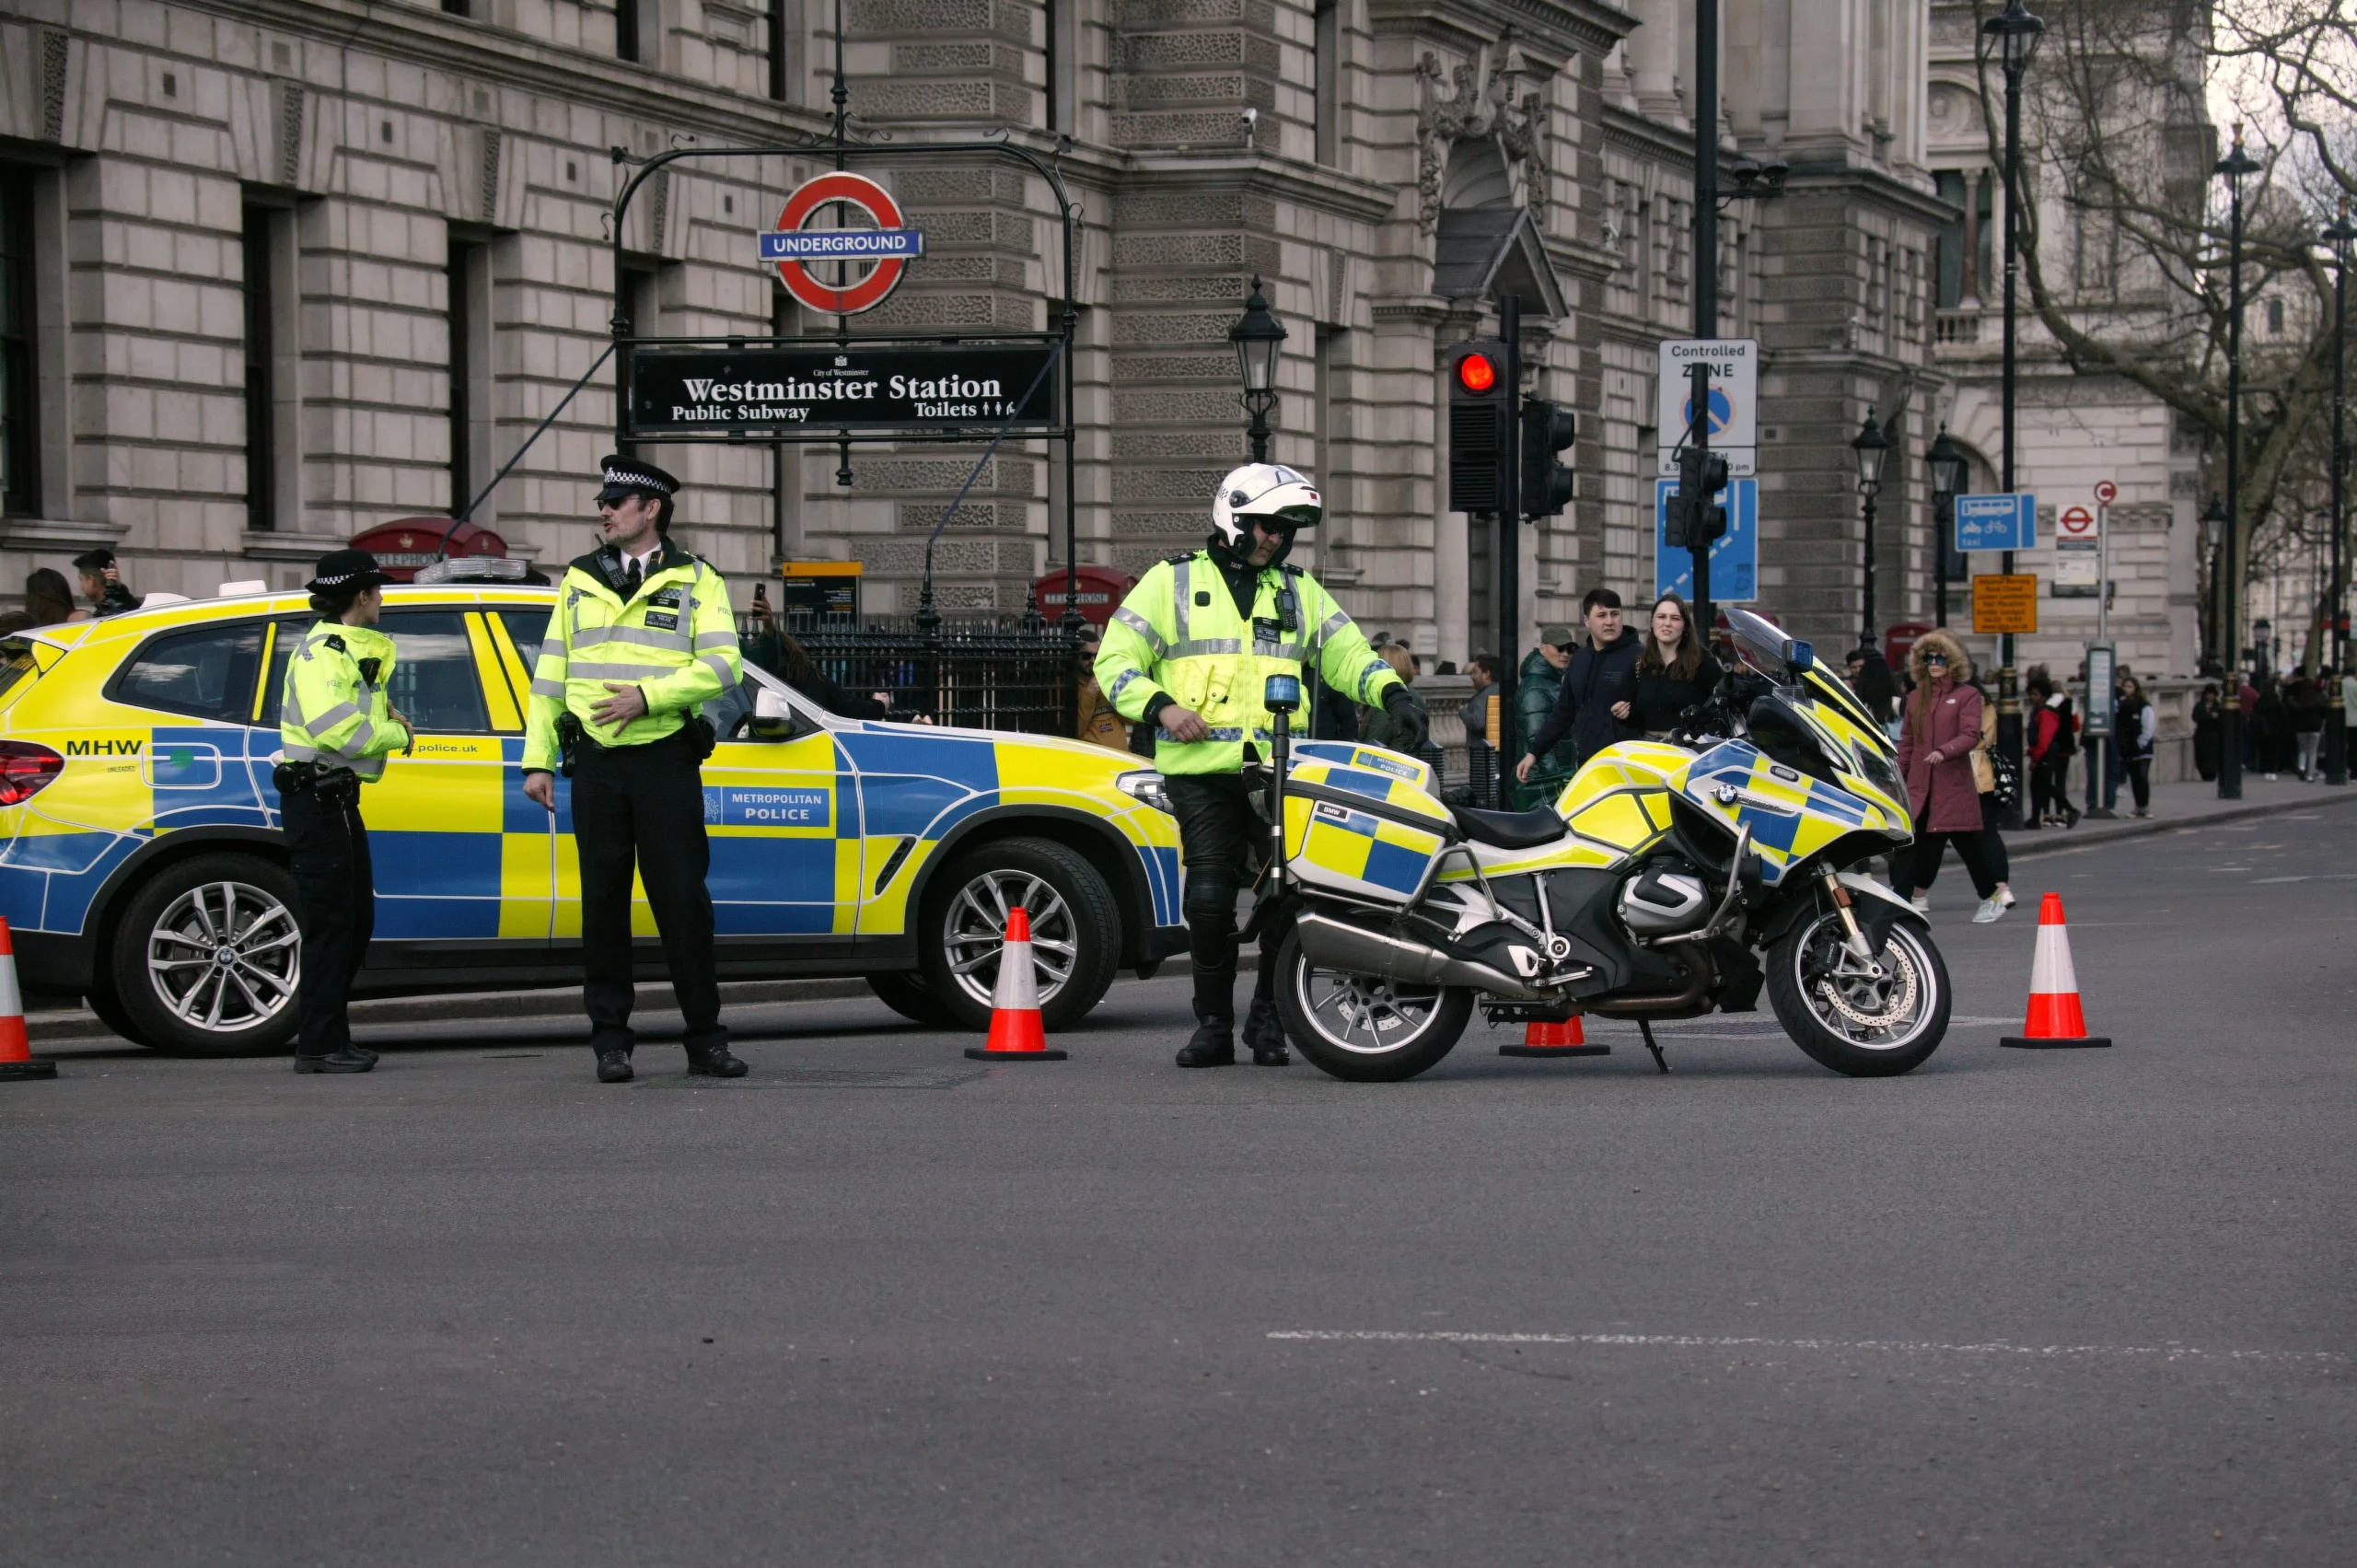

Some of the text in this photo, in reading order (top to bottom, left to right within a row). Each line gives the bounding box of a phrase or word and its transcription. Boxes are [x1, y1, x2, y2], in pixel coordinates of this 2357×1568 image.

[773, 235, 906, 252] UNDERGROUND
[1671, 345, 1746, 357] Controlled
[813, 369, 825, 378] City
[1682, 364, 1734, 377] ZNE
[682, 374, 1002, 401] Westminster Station
[671, 401, 977, 423] Public Subway Toilets
[1665, 463, 1679, 471] 8.3
[1736, 464, 1749, 472] pm
[372, 553, 440, 566] ELEPHON
[67, 740, 143, 755] MHW
[1376, 757, 1416, 772] METROPOLITAN
[1379, 763, 1408, 776] POLICE
[732, 794, 822, 804] METROPOLITAN
[745, 808, 810, 820] POLICE
[1323, 807, 1341, 817] BMW
